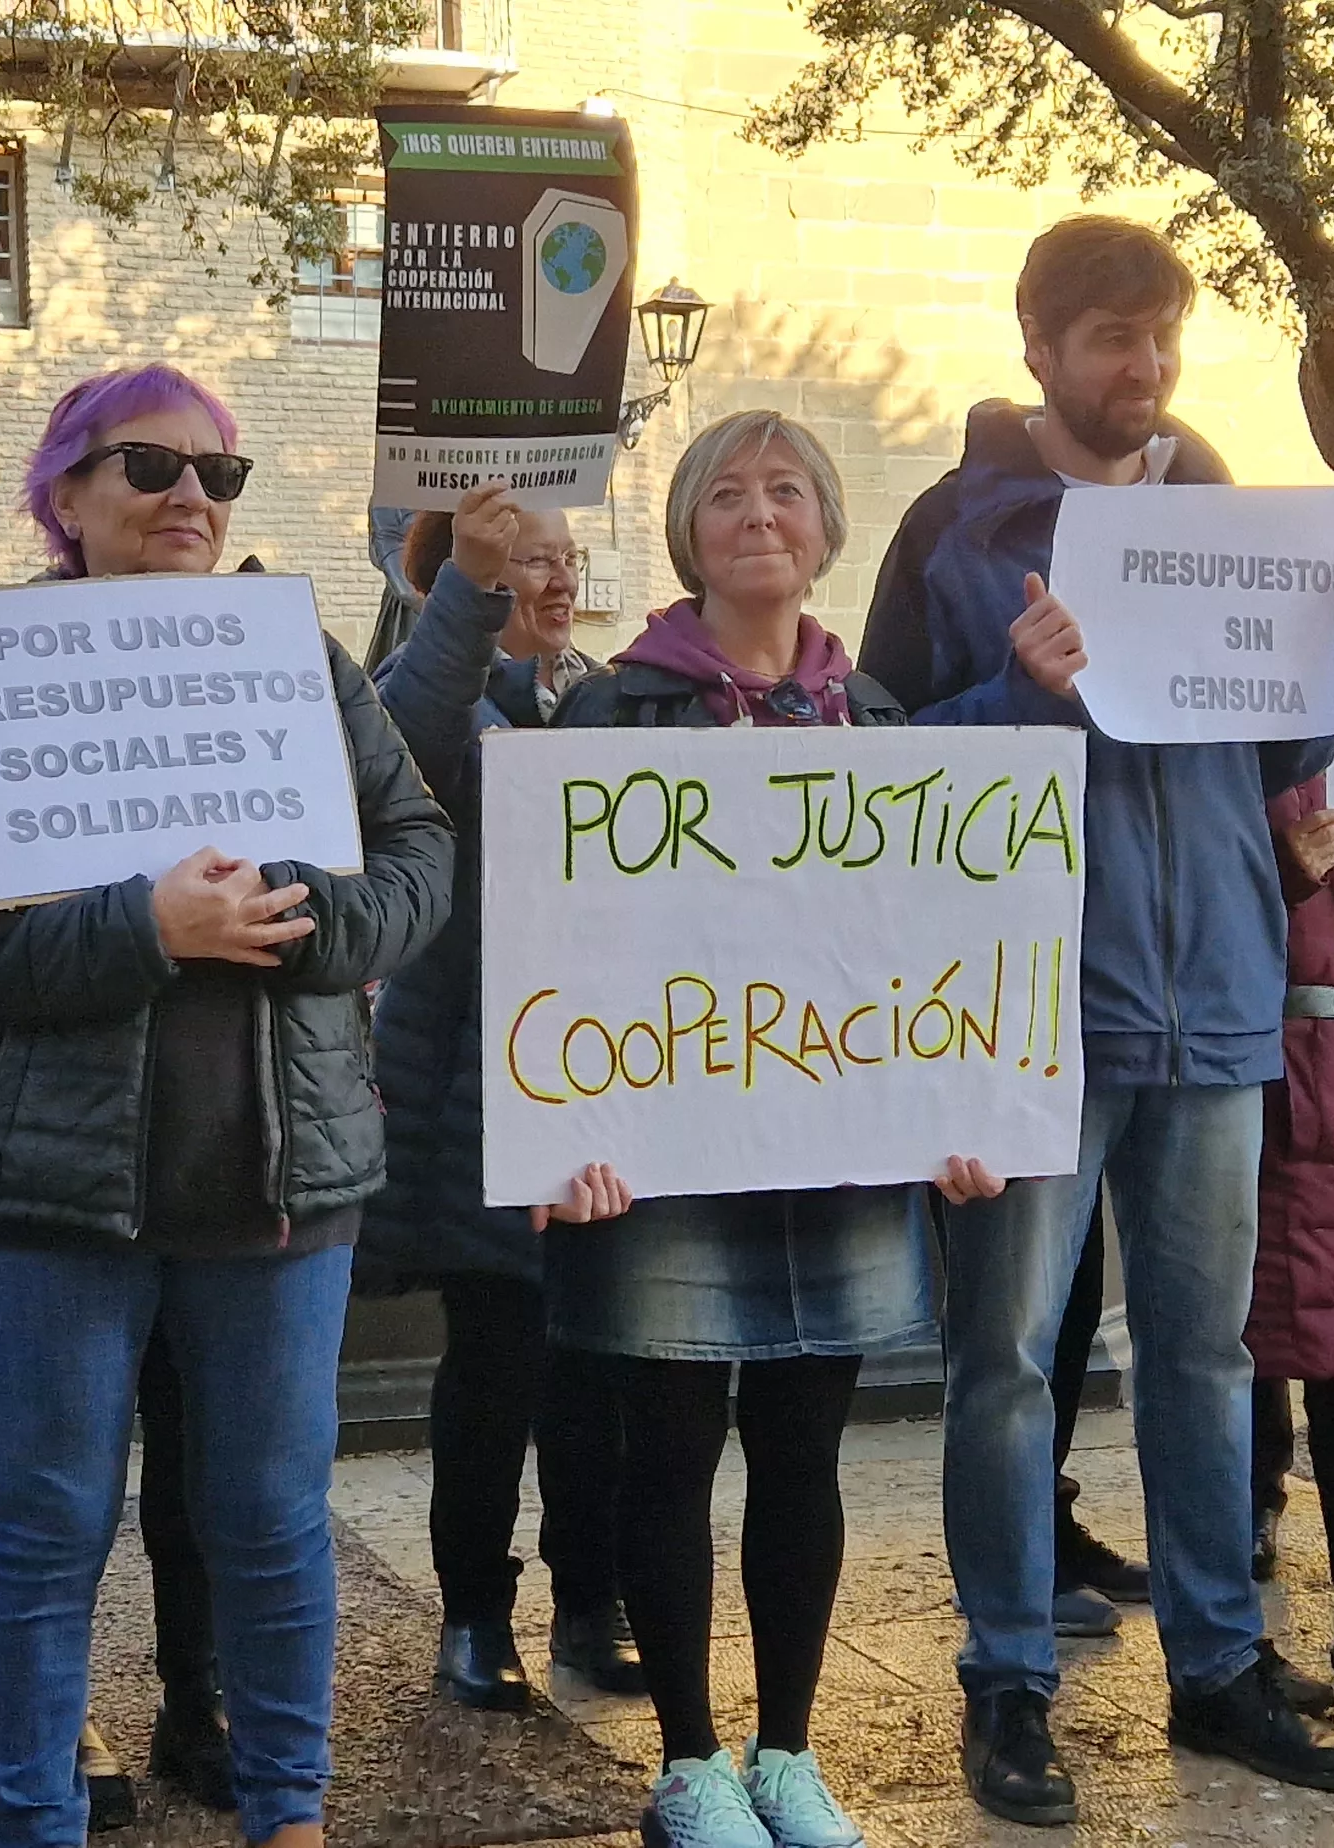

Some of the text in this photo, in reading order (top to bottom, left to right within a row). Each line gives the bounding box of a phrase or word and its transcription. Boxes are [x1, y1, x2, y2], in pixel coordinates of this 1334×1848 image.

[401, 133, 608, 160] ¡NOS QUIEREN ENTERRAR!
[390, 222, 516, 249] ENTIERRO
[389, 249, 463, 268] POR LA
[387, 267, 494, 290] COOPERACIÓN
[386, 290, 507, 311] INTERNACIONAL
[431, 398, 603, 416] AYUNTAMIENTO DE HUESCA
[387, 443, 605, 465] NO AL RECORTE EN COOPERACIÓN
[417, 468, 577, 490] HUESCA SOLIDARIA
[108, 613, 246, 652] UNOS
[1223, 616, 1274, 652] SIN
[1168, 674, 1307, 715] CENSURA
[256, 726, 288, 761] Y
[5, 786, 305, 844] SOLIDARIOS
[563, 769, 737, 883] POR
